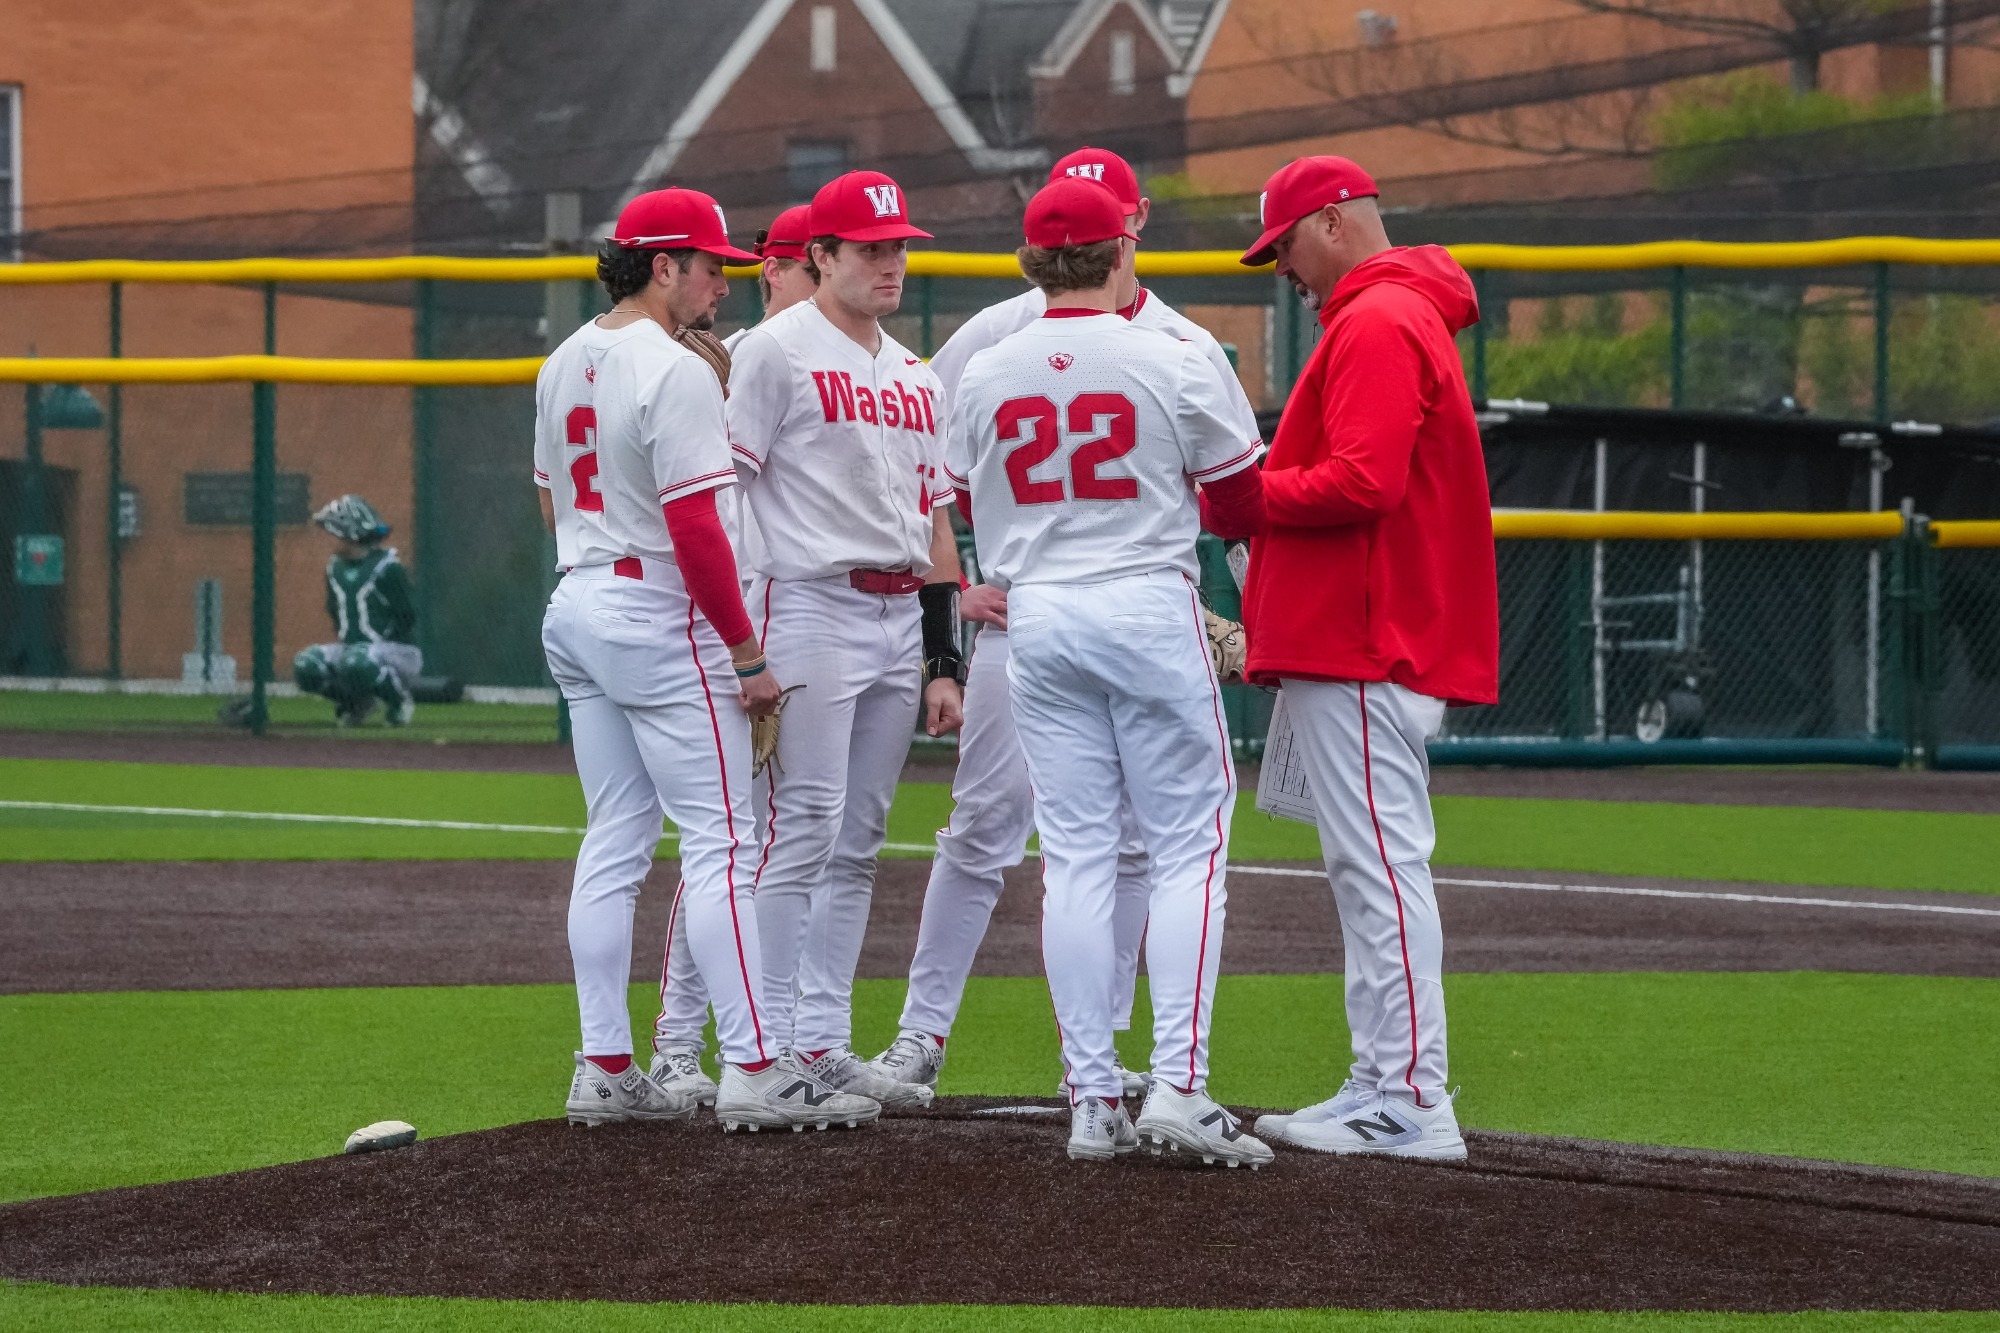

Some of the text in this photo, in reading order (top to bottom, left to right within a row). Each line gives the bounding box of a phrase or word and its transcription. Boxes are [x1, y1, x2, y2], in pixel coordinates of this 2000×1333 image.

[864, 185, 900, 218] W
[565, 404, 605, 514] 2
[993, 390, 1141, 507] 22
